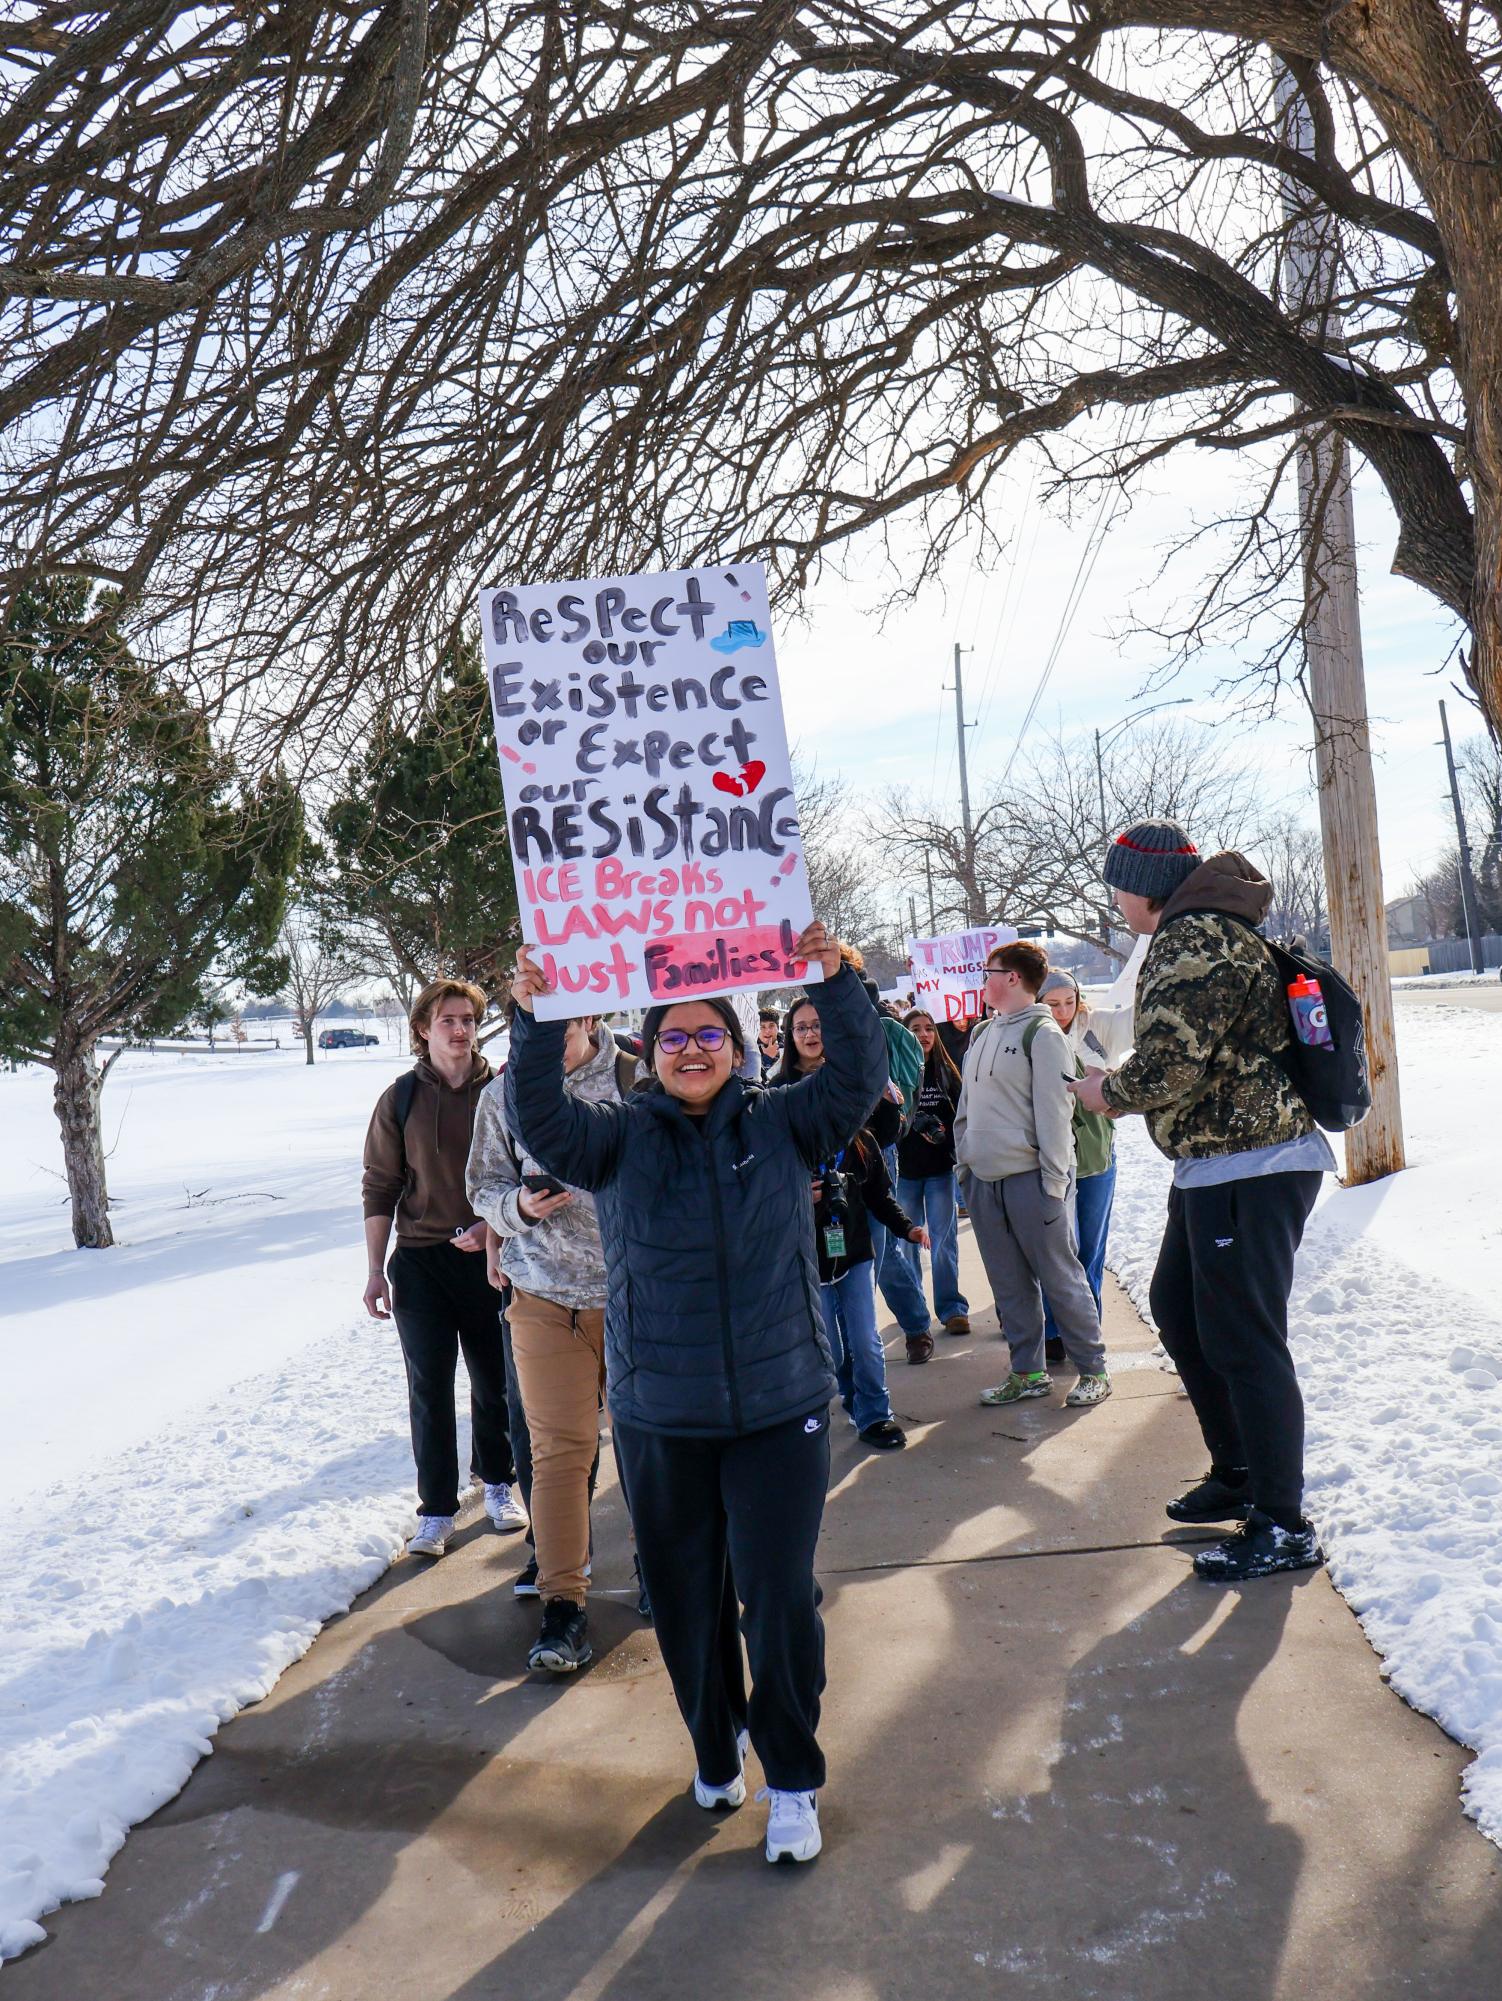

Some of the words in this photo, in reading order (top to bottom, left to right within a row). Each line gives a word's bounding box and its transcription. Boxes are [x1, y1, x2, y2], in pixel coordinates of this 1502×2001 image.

[582, 639, 667, 667] our
[518, 719, 567, 746] or
[519, 777, 601, 804] our
[523, 862, 584, 904] ICE
[685, 888, 767, 933] not
[915, 931, 998, 965] TRUMP
[943, 961, 986, 975] MUGS
[916, 978, 940, 995] MY
